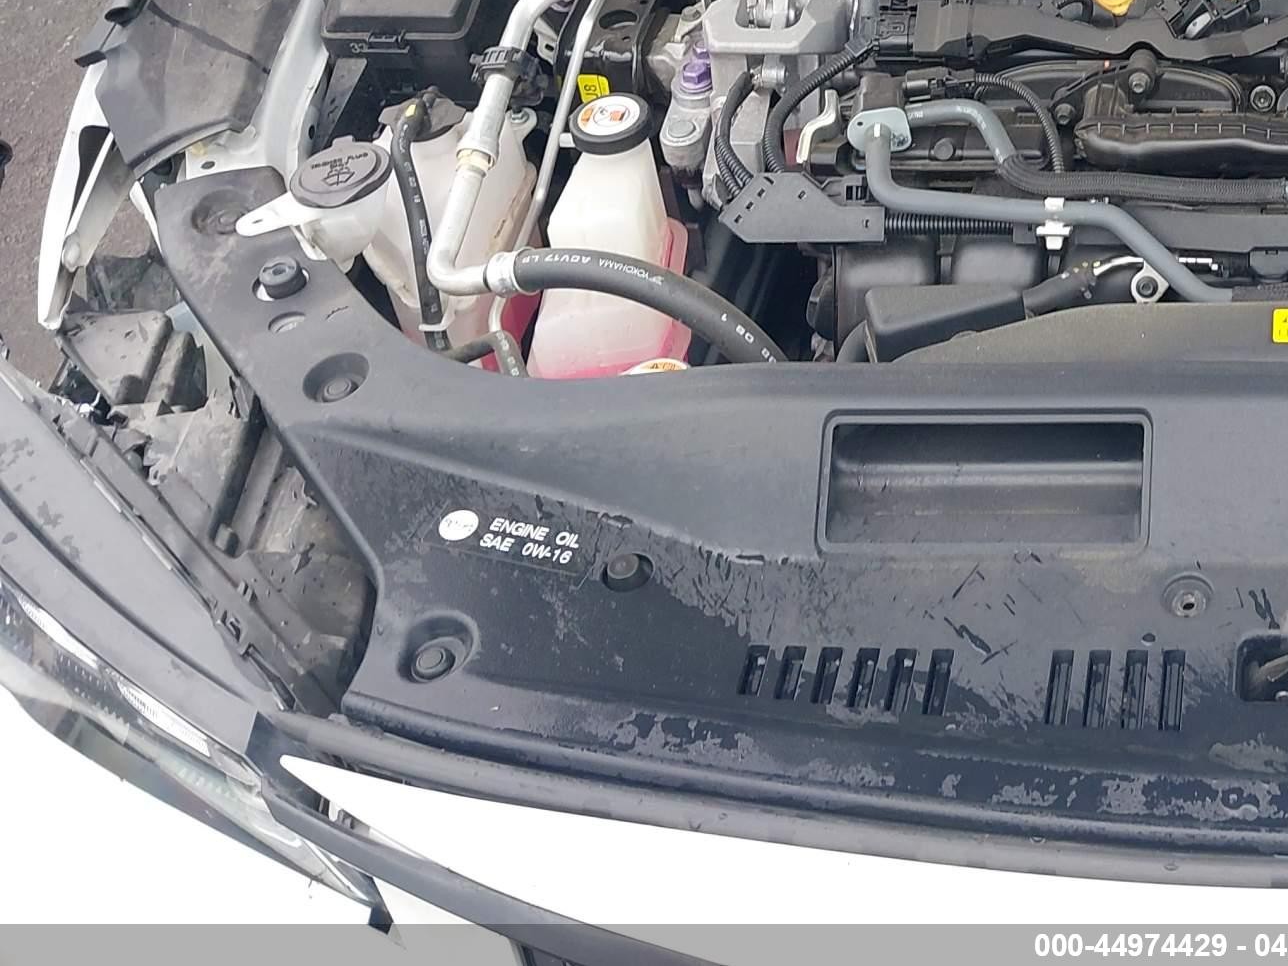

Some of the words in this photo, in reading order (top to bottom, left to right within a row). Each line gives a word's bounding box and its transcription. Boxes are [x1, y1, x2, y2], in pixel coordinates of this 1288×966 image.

[479, 532, 515, 552] SAE
[521, 542, 573, 565] 0W-16
[489, 517, 549, 541] ENGINE
[555, 531, 579, 549] OIL
